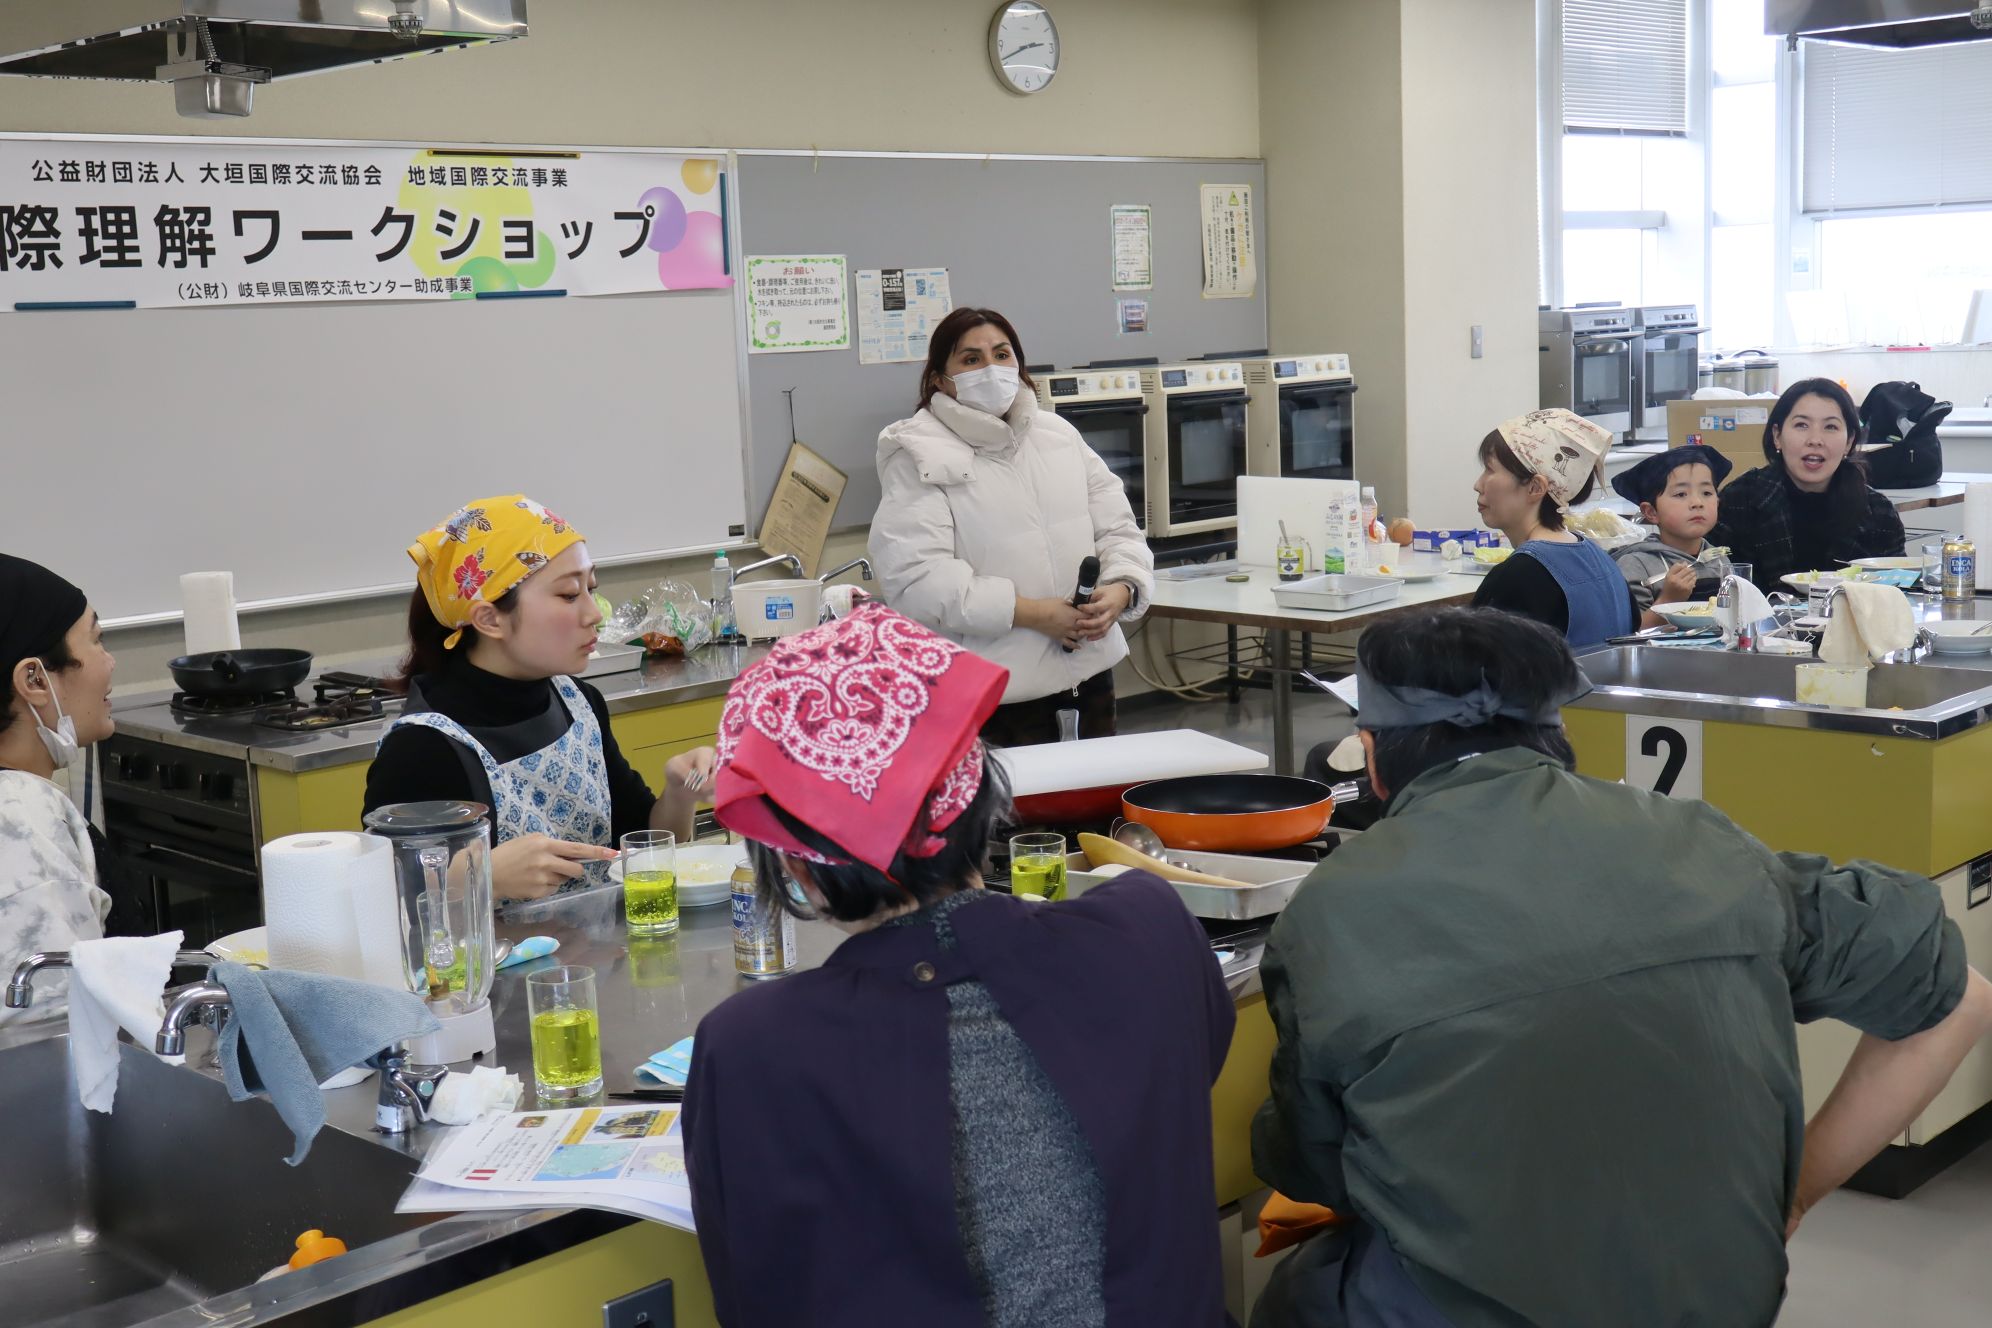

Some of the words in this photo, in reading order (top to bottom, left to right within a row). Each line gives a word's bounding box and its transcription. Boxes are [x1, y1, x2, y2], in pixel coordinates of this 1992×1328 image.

[31, 159, 185, 184] 公益財団法人
[199, 162, 382, 187] 大垣国際交流協会
[407, 165, 569, 188] 地域国際交流事業
[0, 203, 656, 272] 際理解ワークショップ
[783, 266, 815, 276] お願い
[1951, 559, 1971, 567] INCA
[1641, 725, 1687, 796] 2
